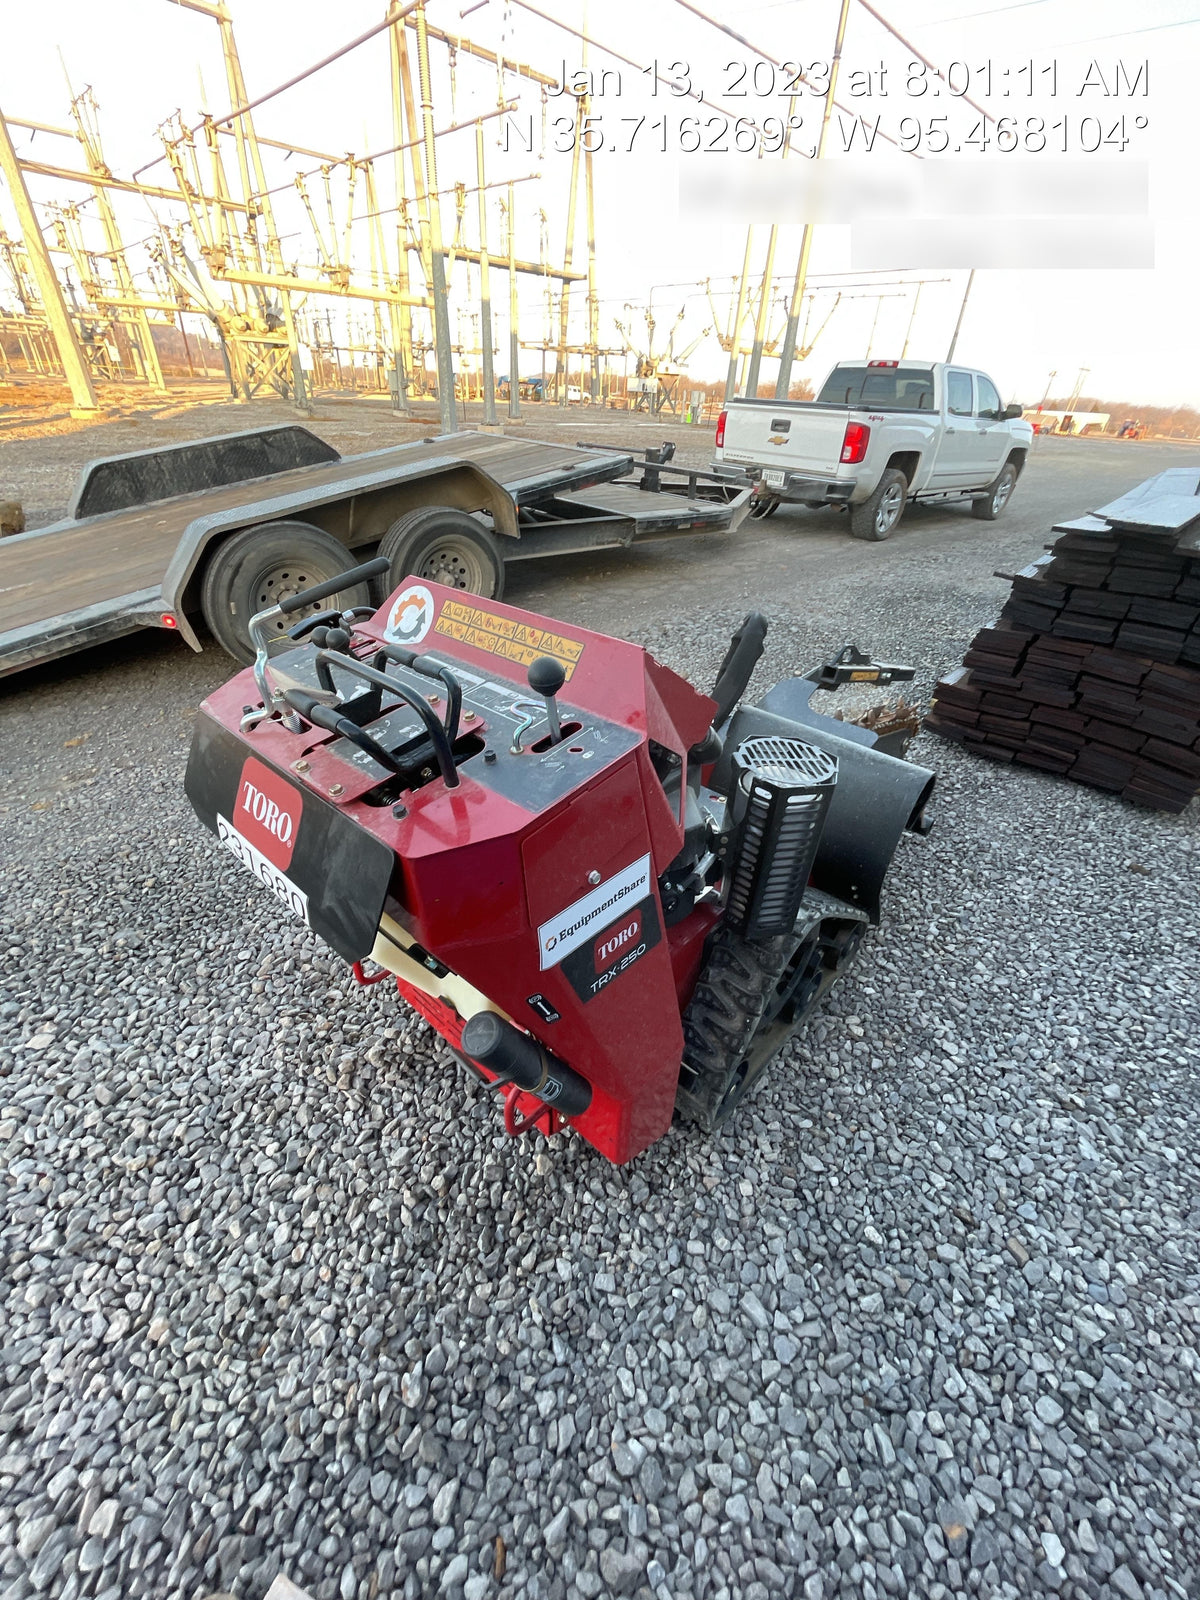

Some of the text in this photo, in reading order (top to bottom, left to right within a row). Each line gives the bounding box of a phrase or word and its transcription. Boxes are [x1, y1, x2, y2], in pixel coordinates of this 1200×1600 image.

[242, 781, 293, 843] TORO
[558, 874, 647, 943] EquipmentShare
[597, 922, 638, 960] TORO
